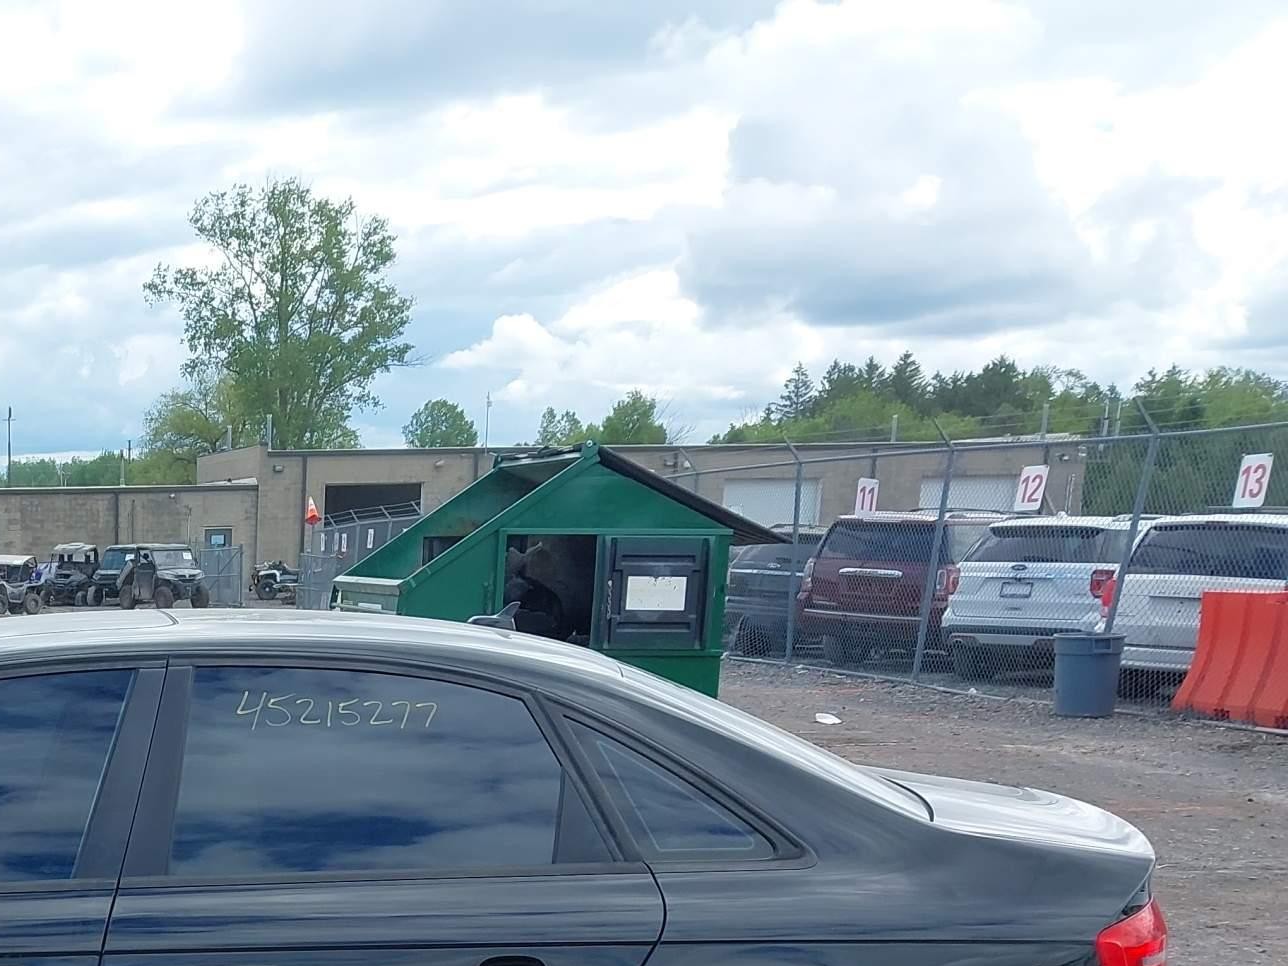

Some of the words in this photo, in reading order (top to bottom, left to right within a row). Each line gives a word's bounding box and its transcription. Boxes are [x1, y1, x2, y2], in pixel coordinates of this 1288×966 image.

[1021, 474, 1043, 503] 12
[1241, 463, 1267, 498] 13
[859, 486, 875, 512] 11
[235, 690, 438, 731] 45215277
